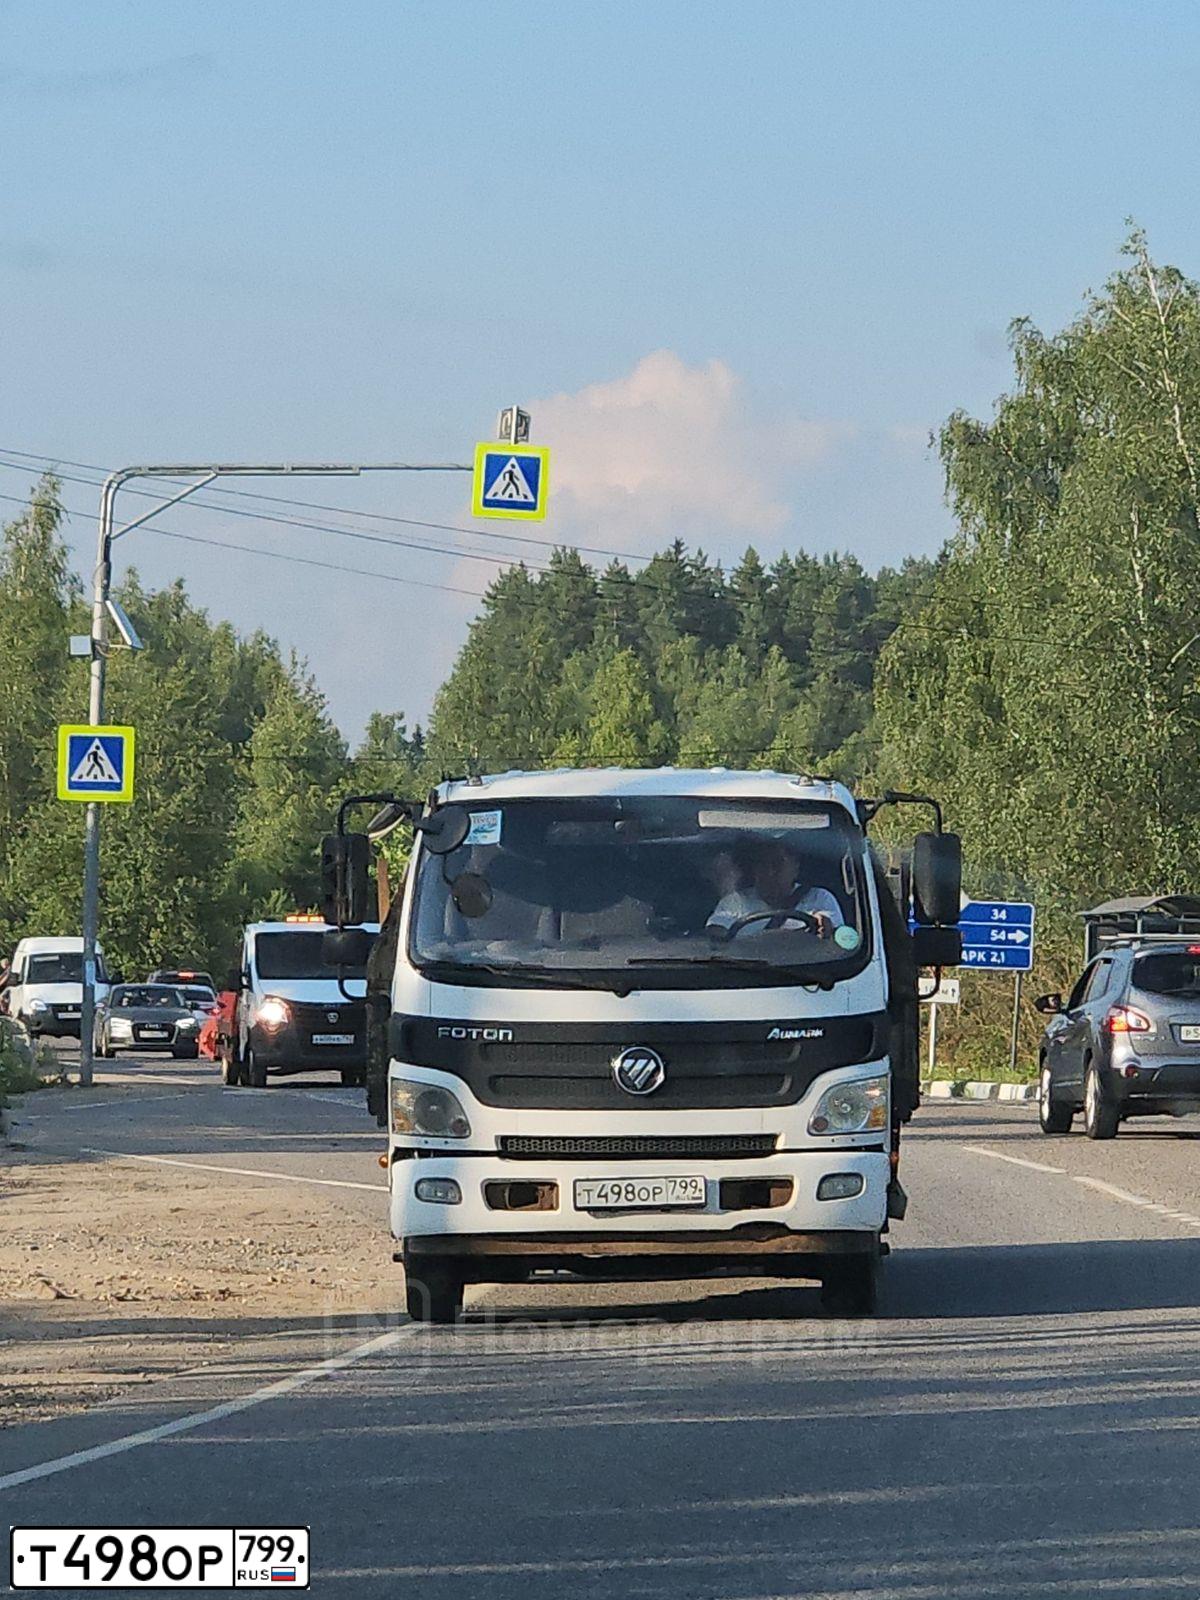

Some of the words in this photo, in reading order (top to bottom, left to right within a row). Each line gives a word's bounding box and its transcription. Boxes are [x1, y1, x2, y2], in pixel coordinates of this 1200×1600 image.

[990, 908, 1007, 920] 34
[990, 929, 1006, 941] 54
[960, 950, 986, 962] АРК
[990, 951, 1005, 964] 2,1
[438, 1026, 513, 1041] FOTON
[582, 1183, 663, 1204] Т498ОР
[668, 1179, 699, 1196] 799
